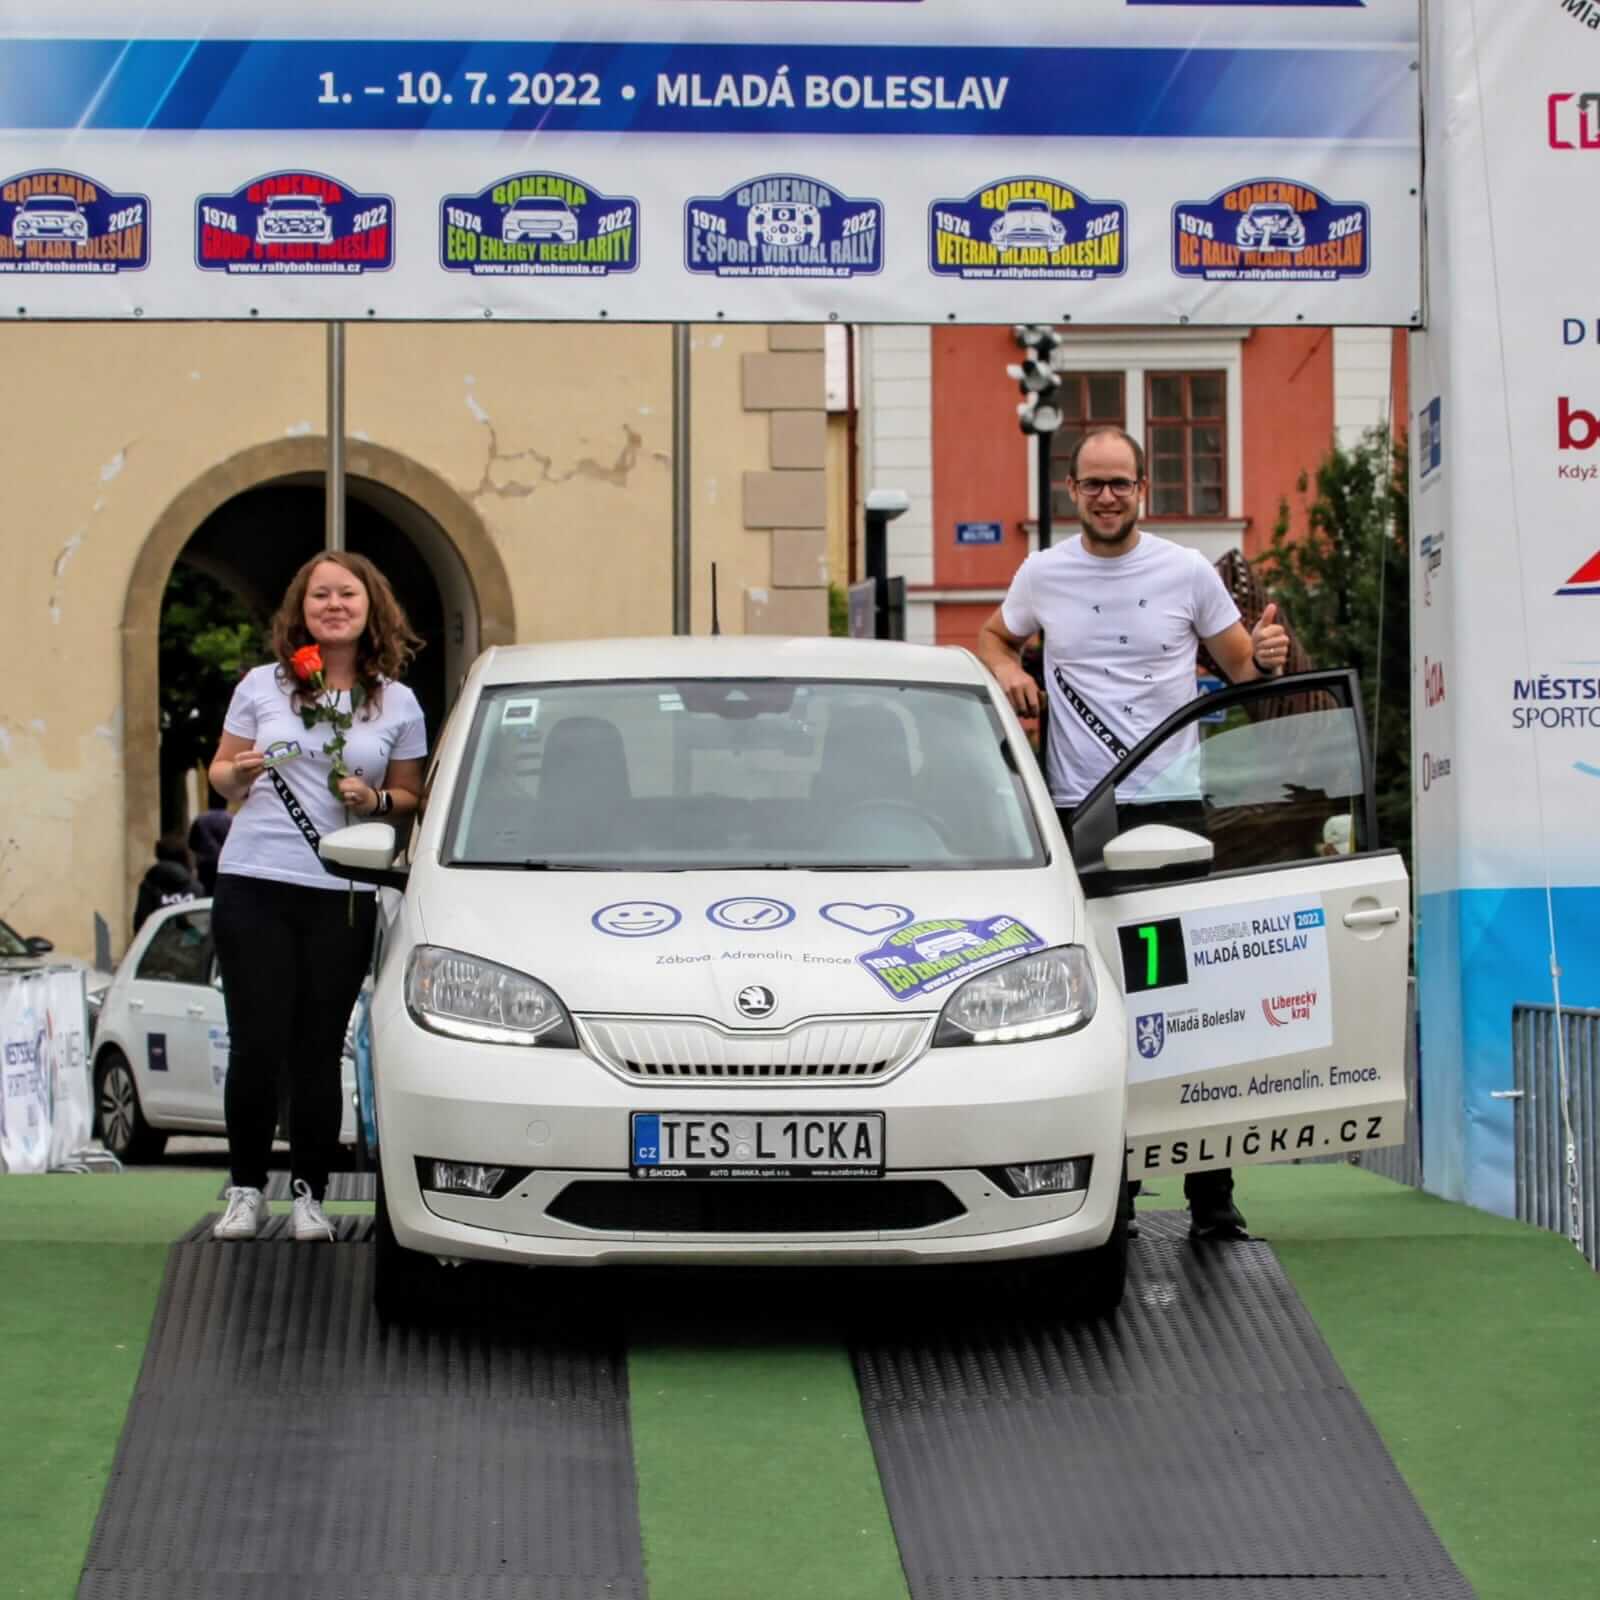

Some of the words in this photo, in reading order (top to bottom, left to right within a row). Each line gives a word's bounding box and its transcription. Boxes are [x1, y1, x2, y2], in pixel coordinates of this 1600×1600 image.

[318, 71, 352, 104] 1.
[397, 71, 453, 104] 10.
[465, 72, 496, 105] 7.
[508, 72, 601, 106] 2022
[657, 64, 795, 107] MLADÁ
[805, 75, 1009, 110] BOLESLAV
[3, 174, 97, 204] BOHEMIA
[492, 176, 587, 205] BOHEMIA
[736, 179, 831, 208] BOHEMIA
[980, 180, 1075, 211] BOHEMIA
[1223, 183, 1318, 212] BOHEMIA
[108, 204, 142, 232] 2022
[203, 206, 237, 232] 1974
[353, 205, 387, 233] 2022
[447, 207, 482, 233] 1974
[598, 206, 632, 234] 2022
[691, 209, 727, 234] 1974
[842, 209, 876, 236] 2022
[936, 211, 970, 237] 1974
[1086, 211, 1119, 238] 2022
[1179, 213, 1214, 239] 1974
[1328, 213, 1362, 240] 2022
[76, 224, 141, 259] BOLESLAV
[447, 224, 477, 260] ECO
[480, 235, 536, 260] ENERGY
[540, 227, 632, 261] REGULARITY
[691, 227, 757, 262] E-SPORT
[761, 240, 828, 263] VIRTUAL
[831, 228, 876, 264] RALLY
[937, 229, 998, 265] VETERAN
[1001, 247, 1049, 265] MLADA
[1051, 231, 1120, 265] BOLESLAV
[1179, 231, 1199, 266] RC
[1202, 239, 1240, 266] RALLY
[1295, 232, 1362, 266] BOLESLAV
[229, 263, 361, 274] www.rallybohemia.cz
[473, 263, 606, 275] www.rallybohemia.cz
[718, 266, 850, 277] www.rallybohemia.cz
[962, 268, 1094, 279] www.rallybohemia.cz
[1205, 269, 1337, 280] www.rallybohemia.cz
[1563, 318, 1600, 345] D
[1557, 396, 1600, 450] b
[1558, 464, 1598, 482] Když
[1513, 674, 1600, 700] MĚSTS
[1252, 914, 1291, 936] RALLY
[1296, 911, 1320, 926] 2022
[865, 955, 907, 969] 1974
[1194, 941, 1240, 967] MLADÁ
[1242, 933, 1308, 959] BOLESLAV
[880, 966, 919, 993] ECO
[1271, 991, 1318, 1010] Liberecký
[1291, 1007, 1310, 1021] kraj
[1167, 1014, 1200, 1034] Mladá
[1202, 1007, 1246, 1028] Boleslav
[1180, 1081, 1242, 1105] Zábava.
[1247, 1068, 1324, 1097] Adrenalin.
[1329, 1065, 1381, 1087] Emoce.
[639, 1148, 657, 1159] CZ
[662, 1121, 730, 1159] TES
[756, 1121, 872, 1159] L1CKA
[648, 1168, 687, 1177] ŠKODA
[709, 1168, 729, 1177] AUTO
